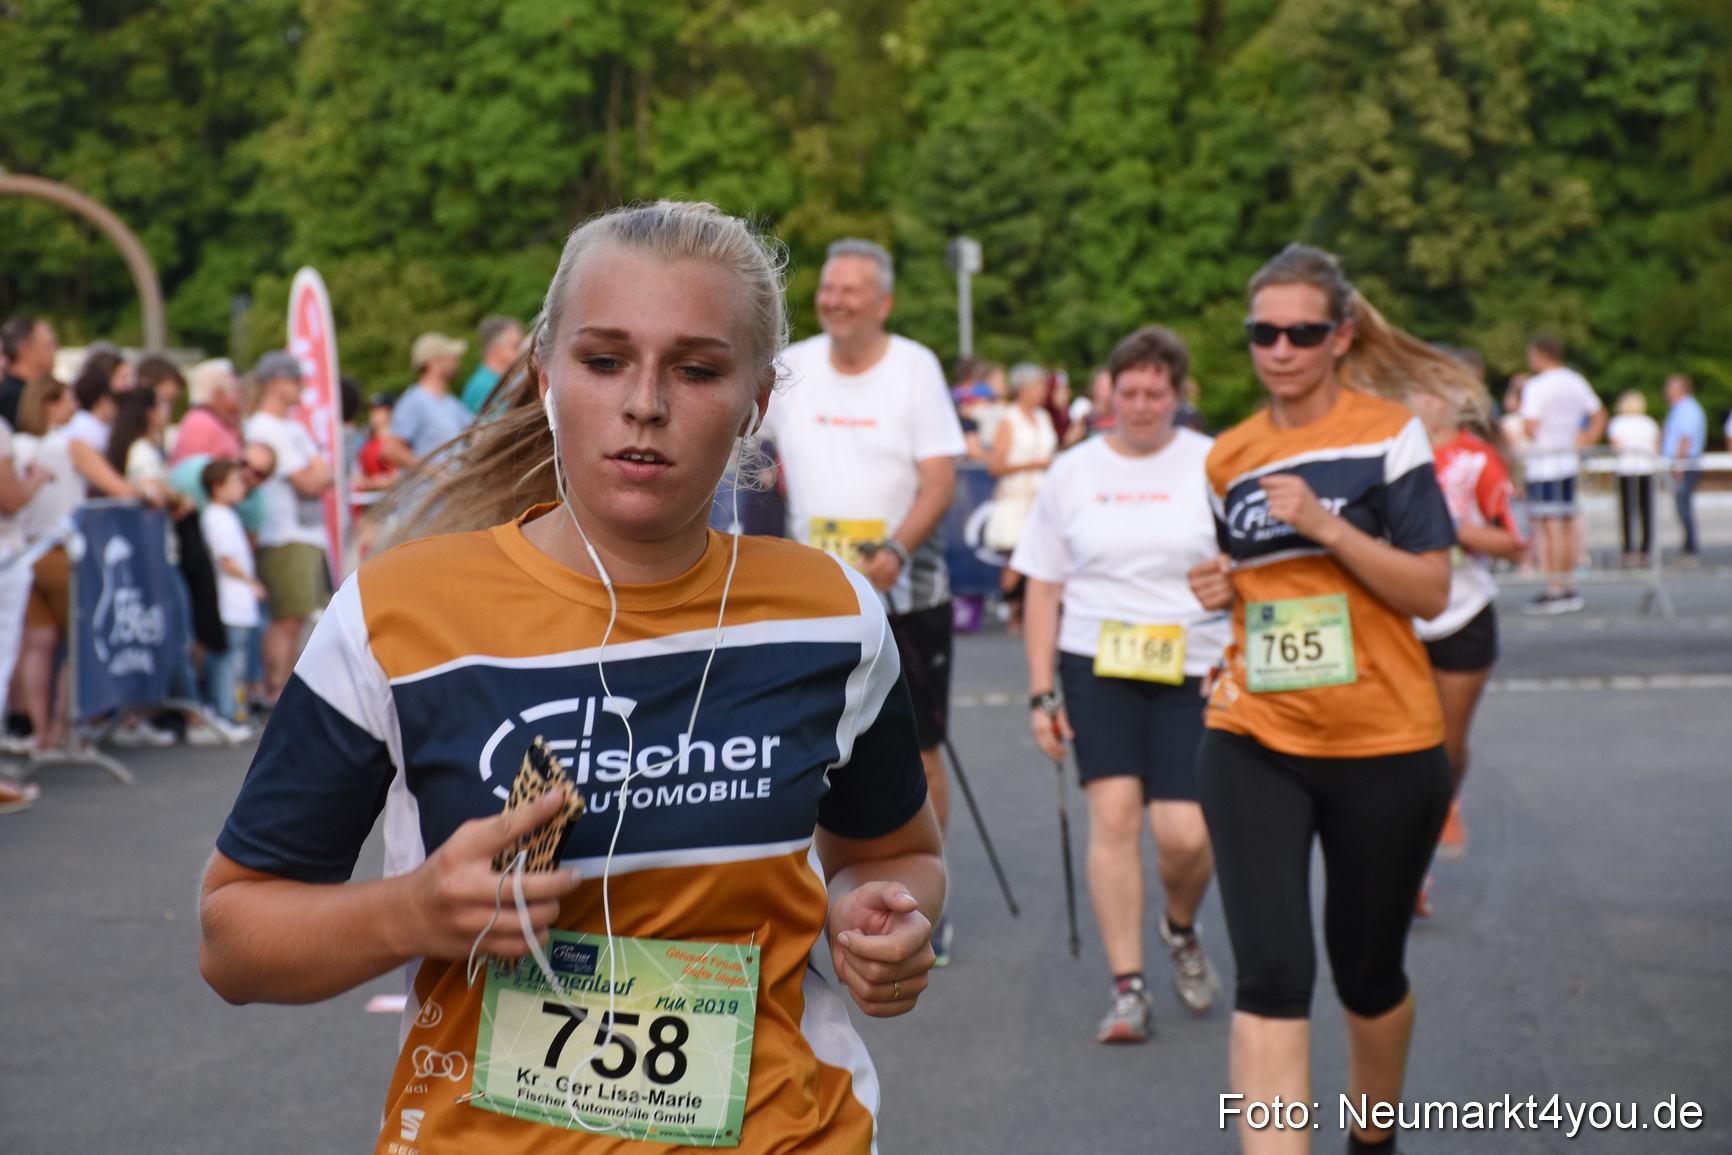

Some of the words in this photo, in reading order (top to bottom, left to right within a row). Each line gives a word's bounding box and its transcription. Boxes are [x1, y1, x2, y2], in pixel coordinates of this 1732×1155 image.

[1113, 638, 1173, 664] 1168
[1262, 630, 1324, 664] 765
[545, 733, 781, 785] Fischer
[584, 777, 772, 814] UTOMOBILE
[692, 999, 739, 1015] 2019
[541, 1001, 690, 1085] 758
[517, 1087, 568, 1108] Fischer
[571, 1099, 649, 1121] Automobile
[653, 1110, 697, 1125] GmbH
[598, 1083, 703, 1109] Lisa-Marie
